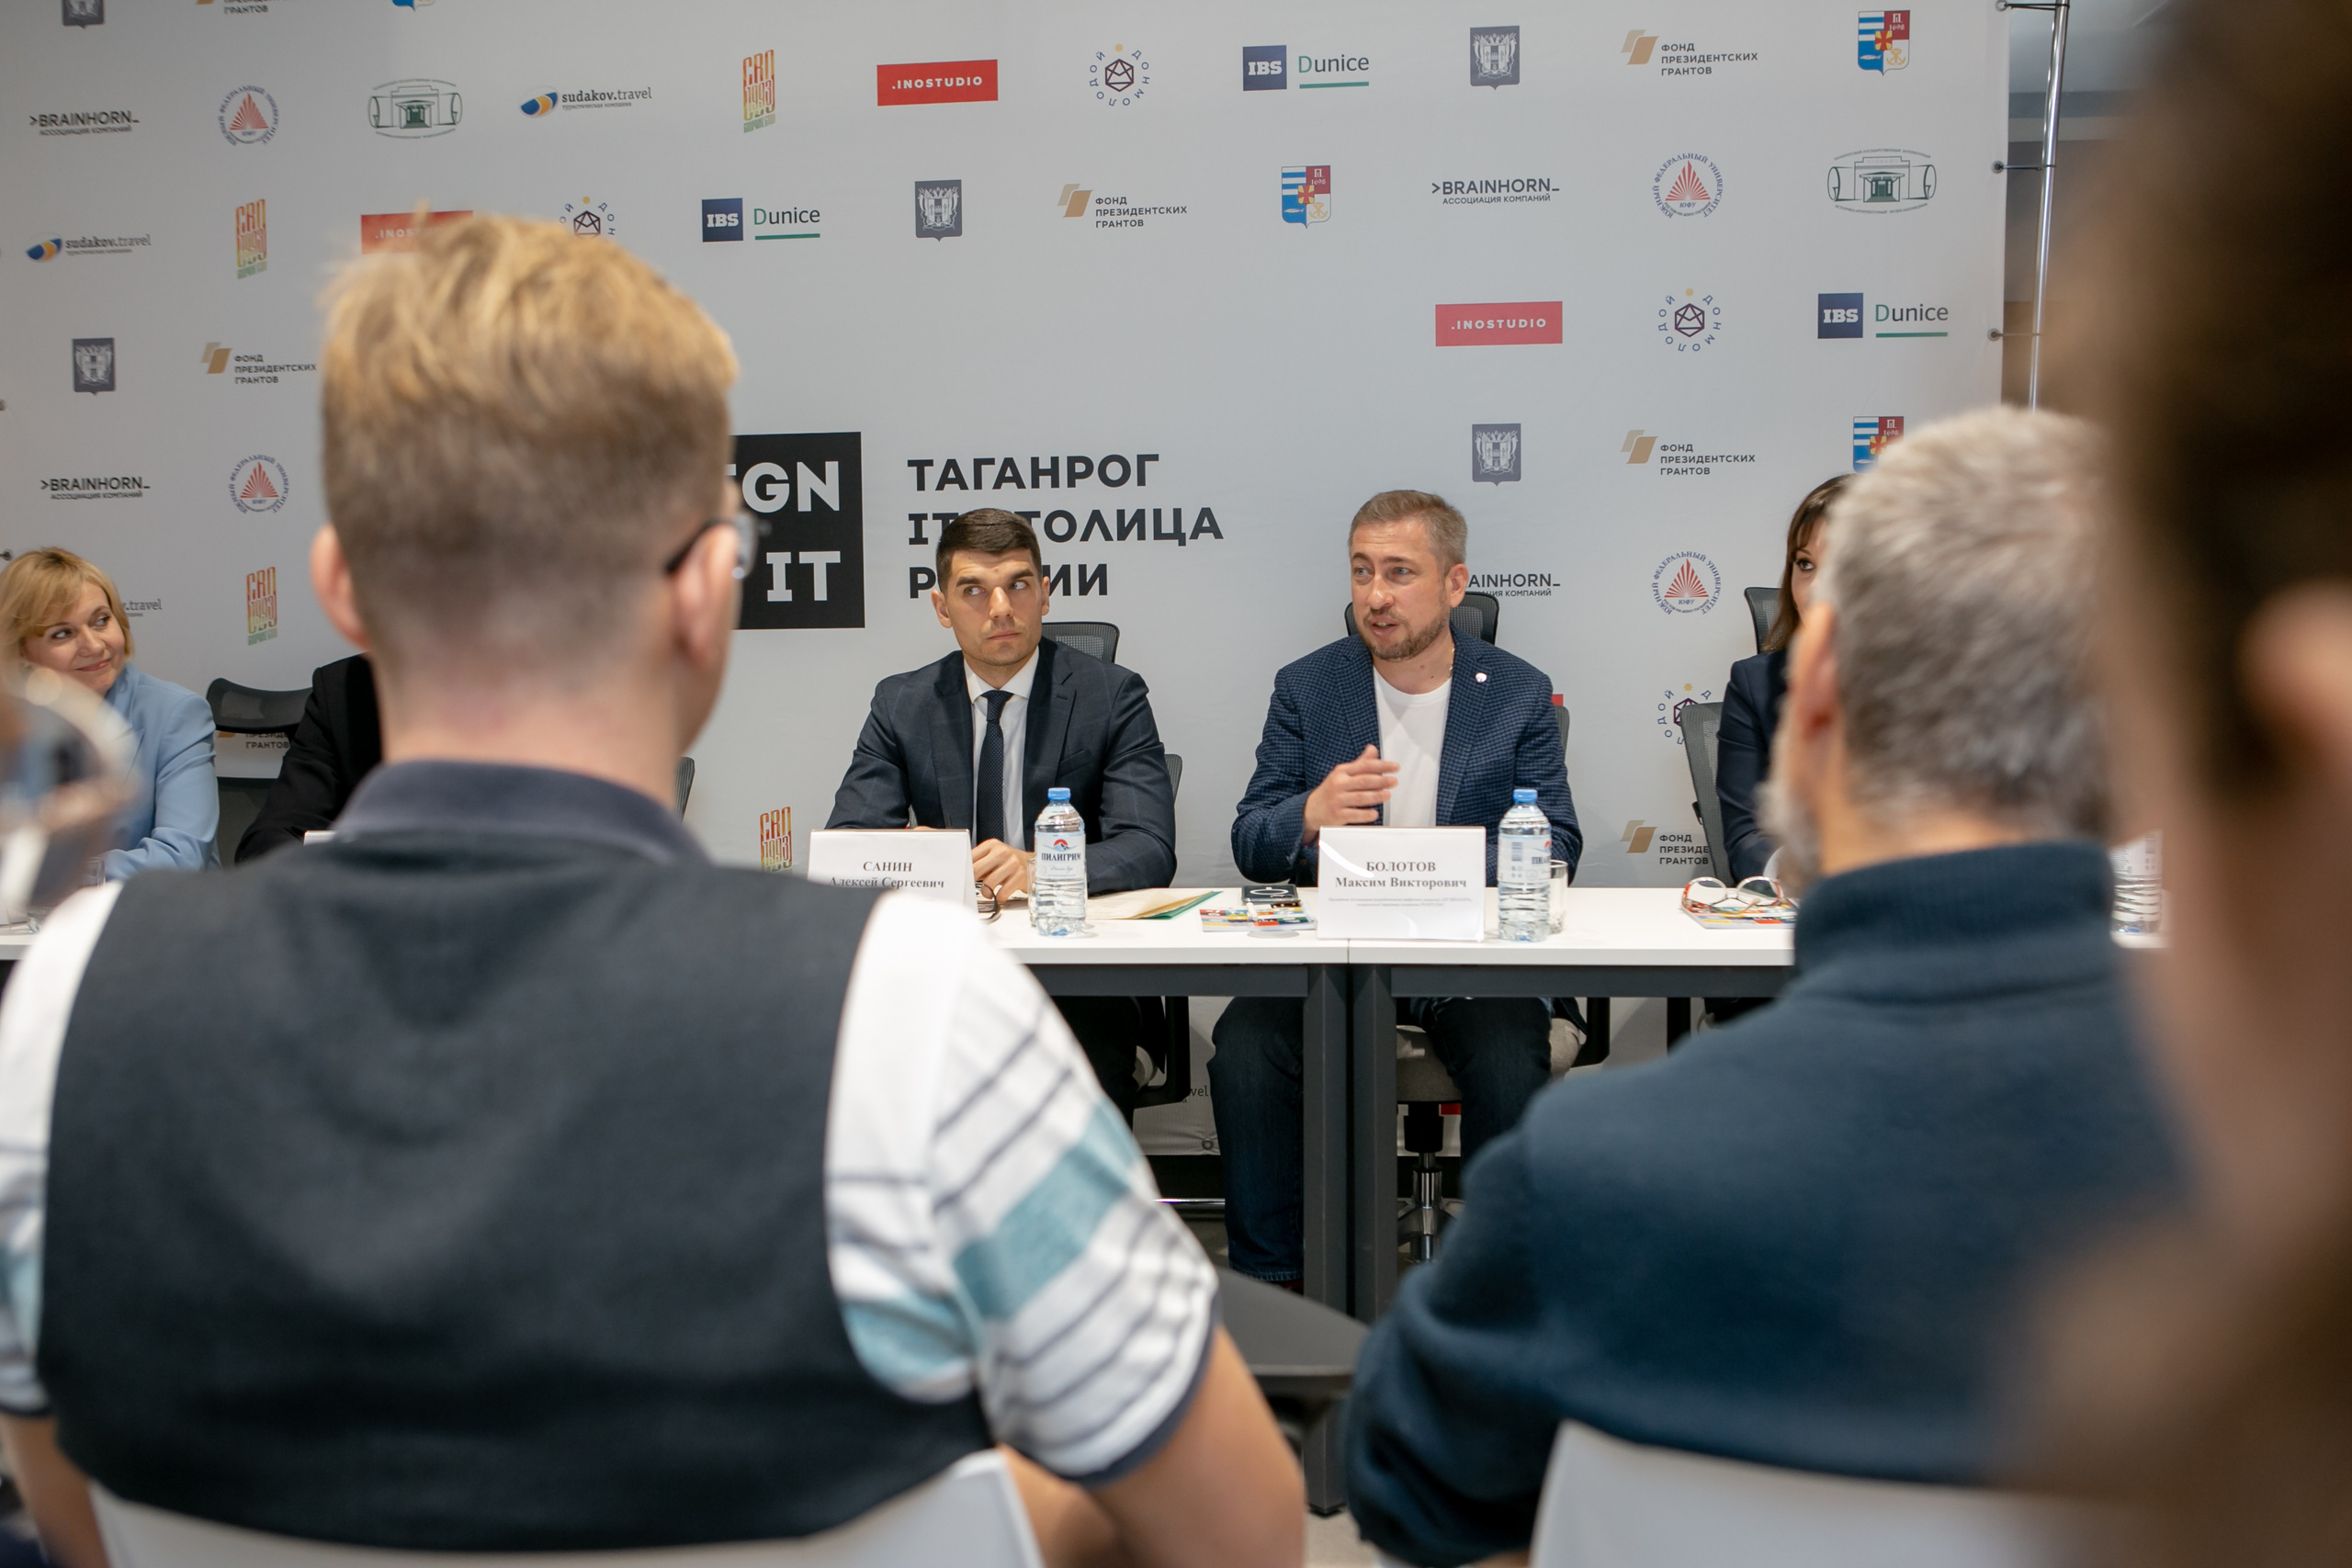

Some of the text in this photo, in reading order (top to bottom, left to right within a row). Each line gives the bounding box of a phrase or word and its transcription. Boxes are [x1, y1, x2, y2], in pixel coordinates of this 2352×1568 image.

[1661, 43, 1695, 51] ФОНД
[1661, 53, 1758, 63] ПРЕЗИДЕНТСКИХ
[1249, 54, 1369, 75] IBS Dunice
[1661, 67, 1712, 75] ГРАНТОВ
[892, 76, 982, 89] .INOSTUDIO
[561, 86, 653, 104] sudakov.travel
[1431, 178, 1560, 195] >BRAINHORN_
[1652, 152, 1724, 219] ЮЖНЫЙ ФЕДЕРАЛЬНЫЙ УНИВЕРСИТЕТ
[1095, 197, 1127, 205] ФОНД
[1442, 194, 1551, 205] АССОЦИАЦИЯ КОМПАНИЙ
[707, 208, 820, 227] IBS Dunice
[1096, 207, 1187, 216] ПРЕЗИДЕНТСКИХ
[1096, 220, 1144, 228] ГРАНТОВ
[1824, 304, 1949, 322] IBS Dunice
[1452, 319, 1546, 329] .INOSTUDIO
[234, 355, 264, 364] ФОНД
[234, 364, 317, 373] ПРЕЗИДЕНТСКИХ
[234, 376, 279, 384] ГРАНТОВ
[1660, 444, 1693, 452] ФОНД
[1660, 455, 1755, 464] ПРЕЗИДЕНТСКИХ
[908, 454, 1159, 491] ТАГАНРОГ
[40, 476, 152, 491] >BRAINHORN_
[727, 461, 840, 513] GN
[1013, 507, 1224, 547] ТОЛИЦА
[766, 551, 840, 602] IT
[909, 562, 1109, 599] РИИ
[1467, 573, 1561, 589] AINHORN_
[1651, 551, 1722, 615] ЮЖНЫЙ ФЕДЕРАЛЬНЫЙ УНИВЕРСИТЕТ
[1506, 589, 1551, 597] КОМПАНИЙ
[1659, 834, 1692, 842] ФОНД
[1659, 846, 1709, 854] ПРЕЗИДЕ
[1041, 852, 1081, 862] ПИЛИГРИМ
[1659, 857, 1708, 865] ГРАНТОВ
[862, 860, 913, 874] САНИН
[1366, 861, 1436, 873] БОЛОТОВ
[830, 876, 946, 890] Алексей Сергеевич
[1335, 876, 1467, 890] Максим Викторович
